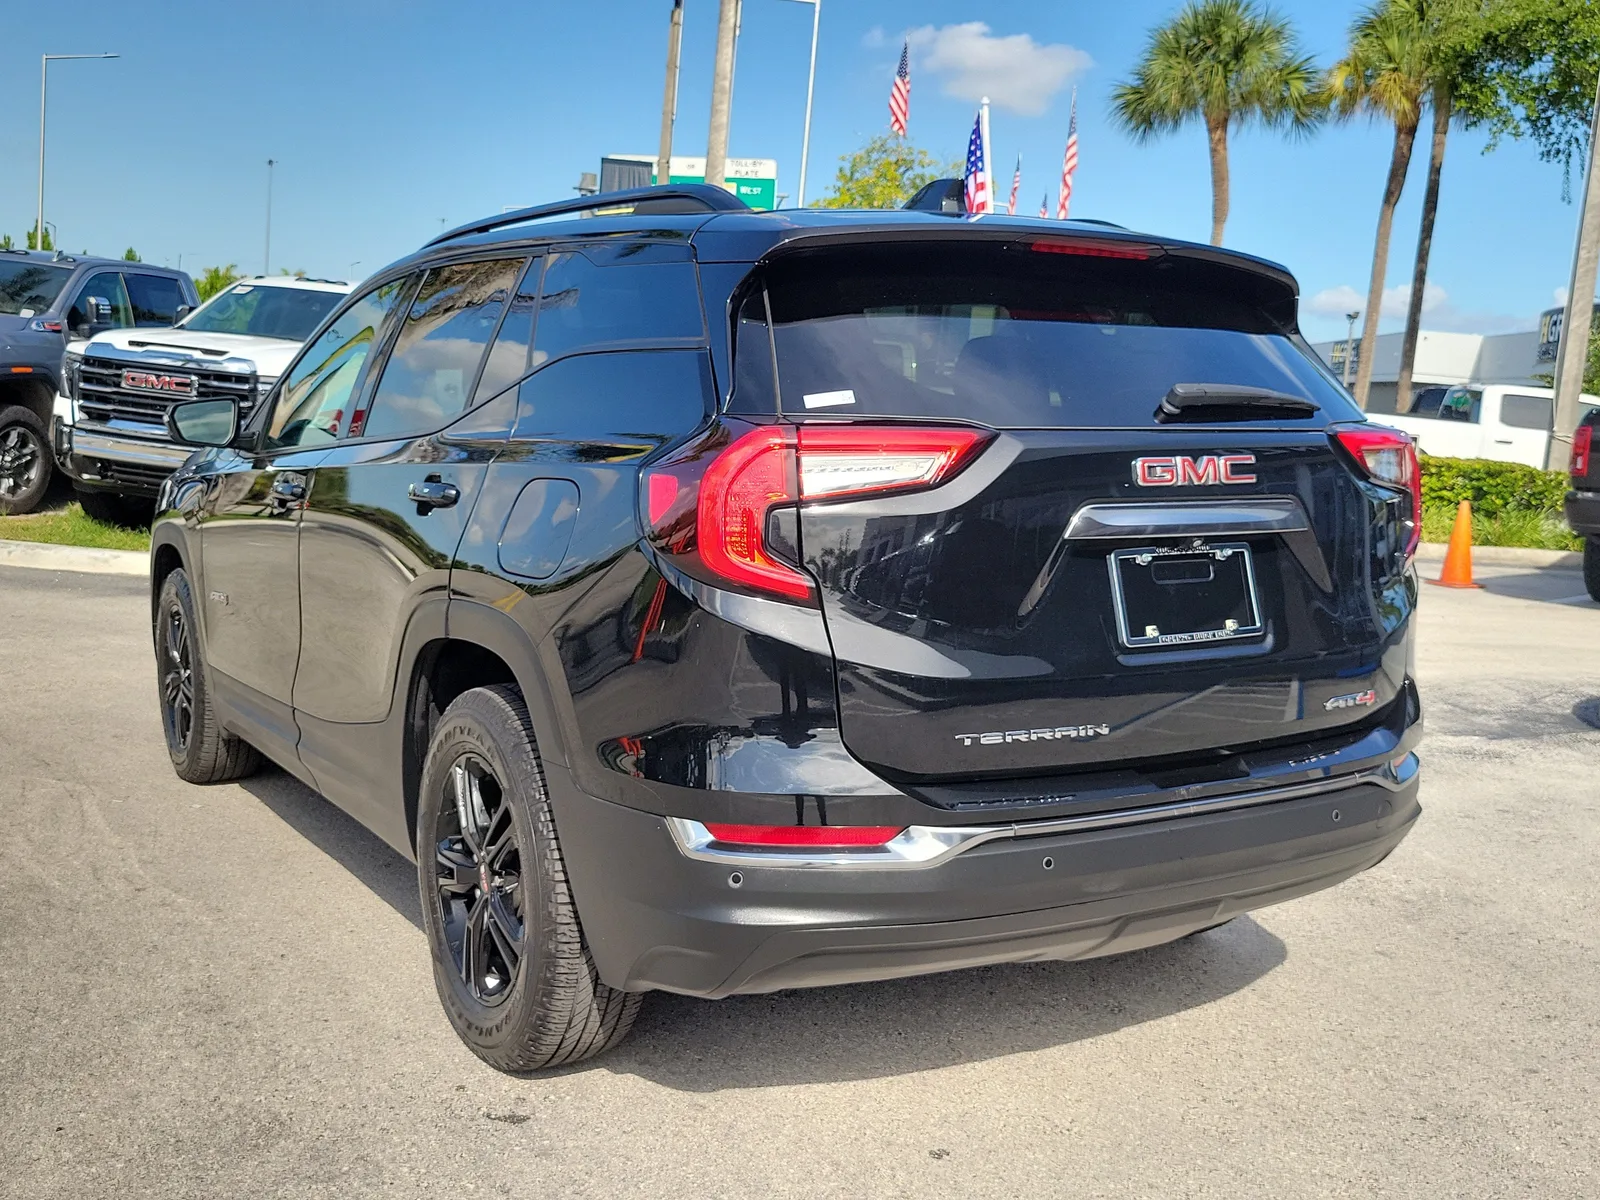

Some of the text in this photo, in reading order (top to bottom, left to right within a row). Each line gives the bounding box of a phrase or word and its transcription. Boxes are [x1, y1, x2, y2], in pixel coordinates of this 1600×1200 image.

[735, 169, 759, 178] PLATE
[739, 185, 763, 195] WEST
[125, 371, 192, 393] GMC
[1131, 455, 1257, 487] GMC
[1323, 689, 1376, 711] AT4
[954, 723, 1110, 746] TERRAIN
